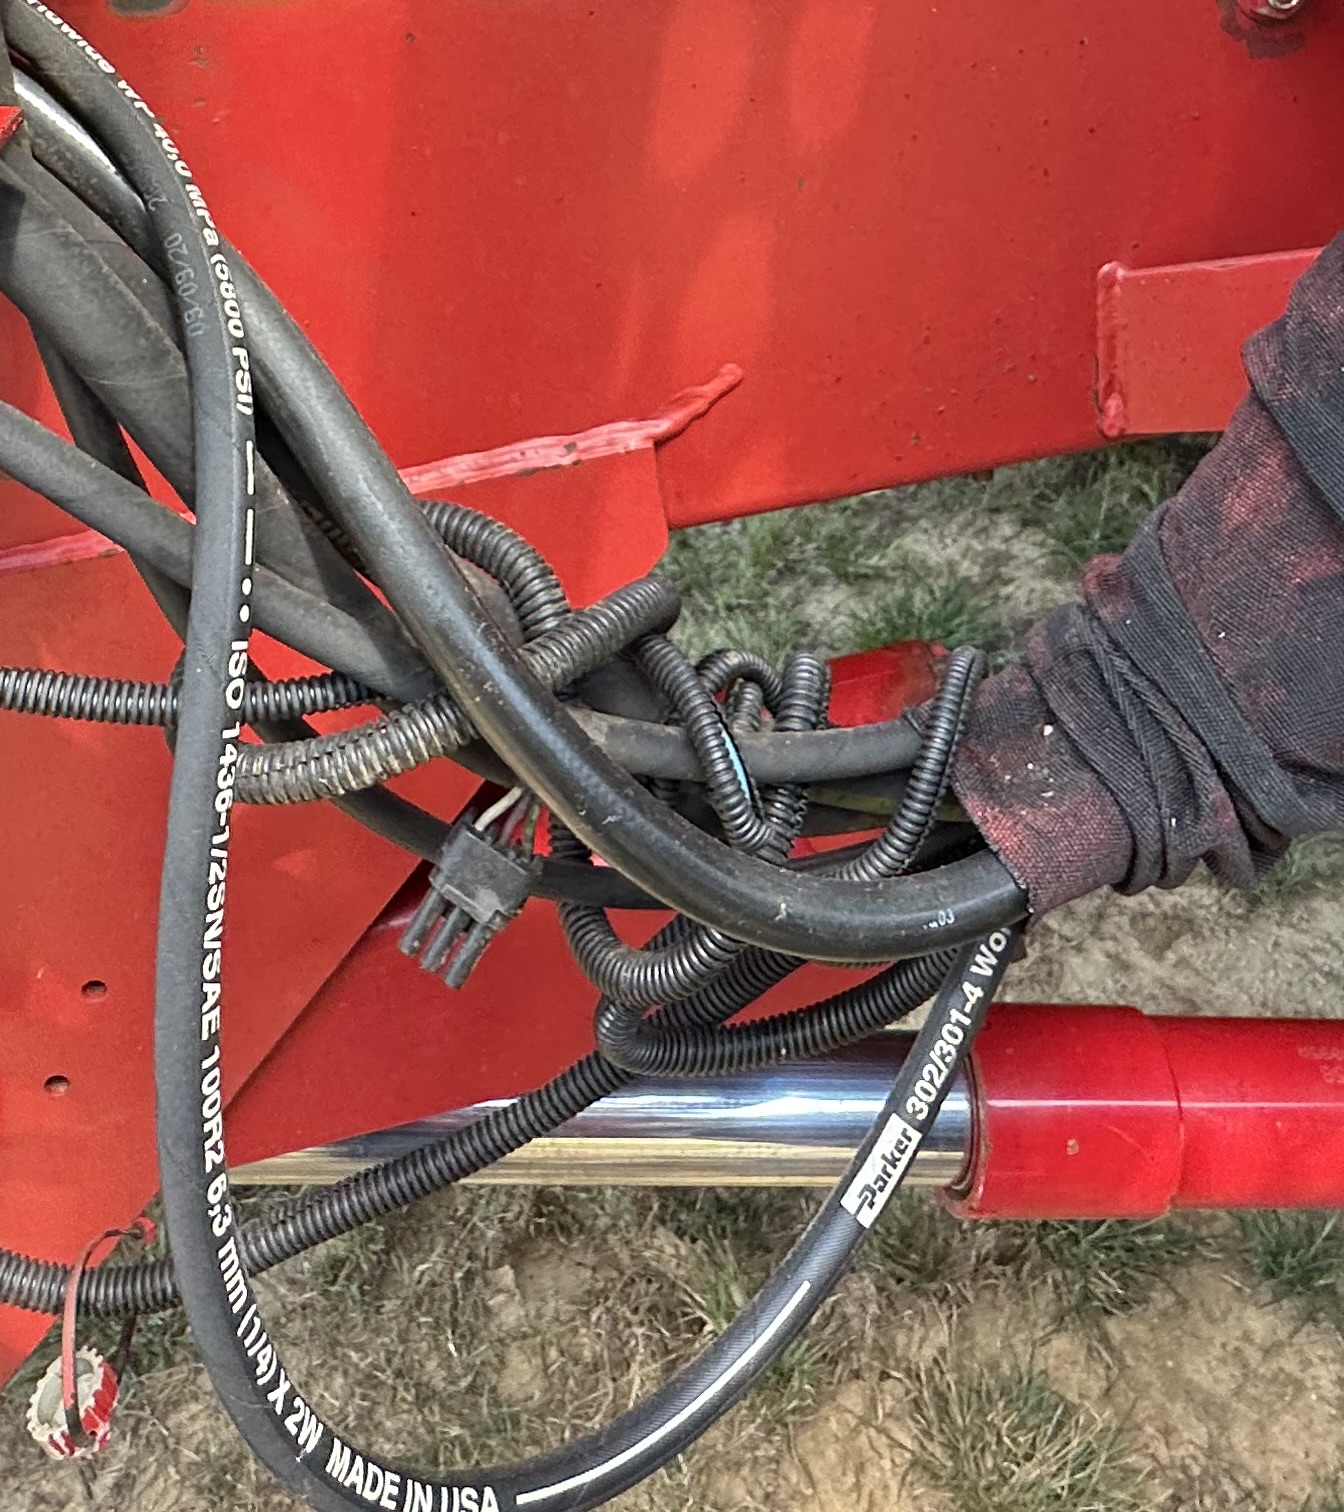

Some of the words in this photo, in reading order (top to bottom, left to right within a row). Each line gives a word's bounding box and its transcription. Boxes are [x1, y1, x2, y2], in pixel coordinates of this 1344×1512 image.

[210, 253, 245, 339] (5800
[232, 346, 254, 416] PSI)
[225, 640, 249, 710] ISO
[201, 1045, 227, 1174] 100R2
[854, 1126, 913, 1217] Parker
[906, 980, 984, 1122] 302/301-4
[207, 1172, 233, 1238] 6,3
[217, 1236, 248, 1315] mm
[236, 1303, 278, 1386] (1/4)
[284, 1395, 325, 1454] 2W
[325, 1437, 401, 1511] MADE
[402, 1478, 434, 1512] IN
[441, 1485, 500, 1512] USA
